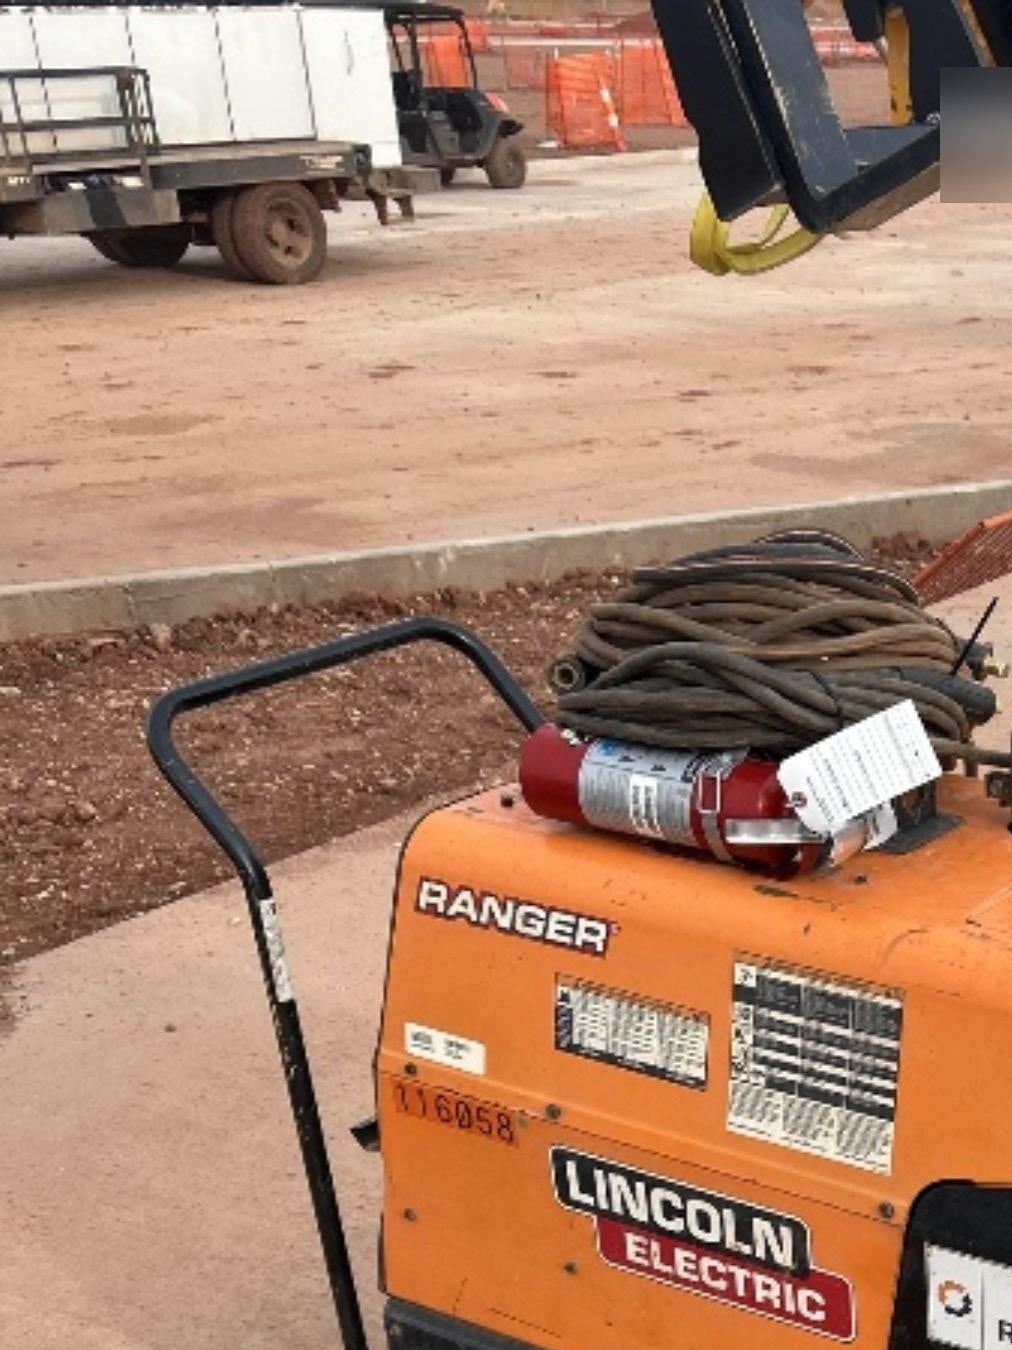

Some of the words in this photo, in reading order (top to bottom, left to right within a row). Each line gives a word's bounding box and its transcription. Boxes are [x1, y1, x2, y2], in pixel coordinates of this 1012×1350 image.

[418, 880, 608, 953] RANGER
[395, 1081, 514, 1146] 116058
[565, 1160, 793, 1267] LINCOLN
[625, 1232, 826, 1322] ELECTRIC
